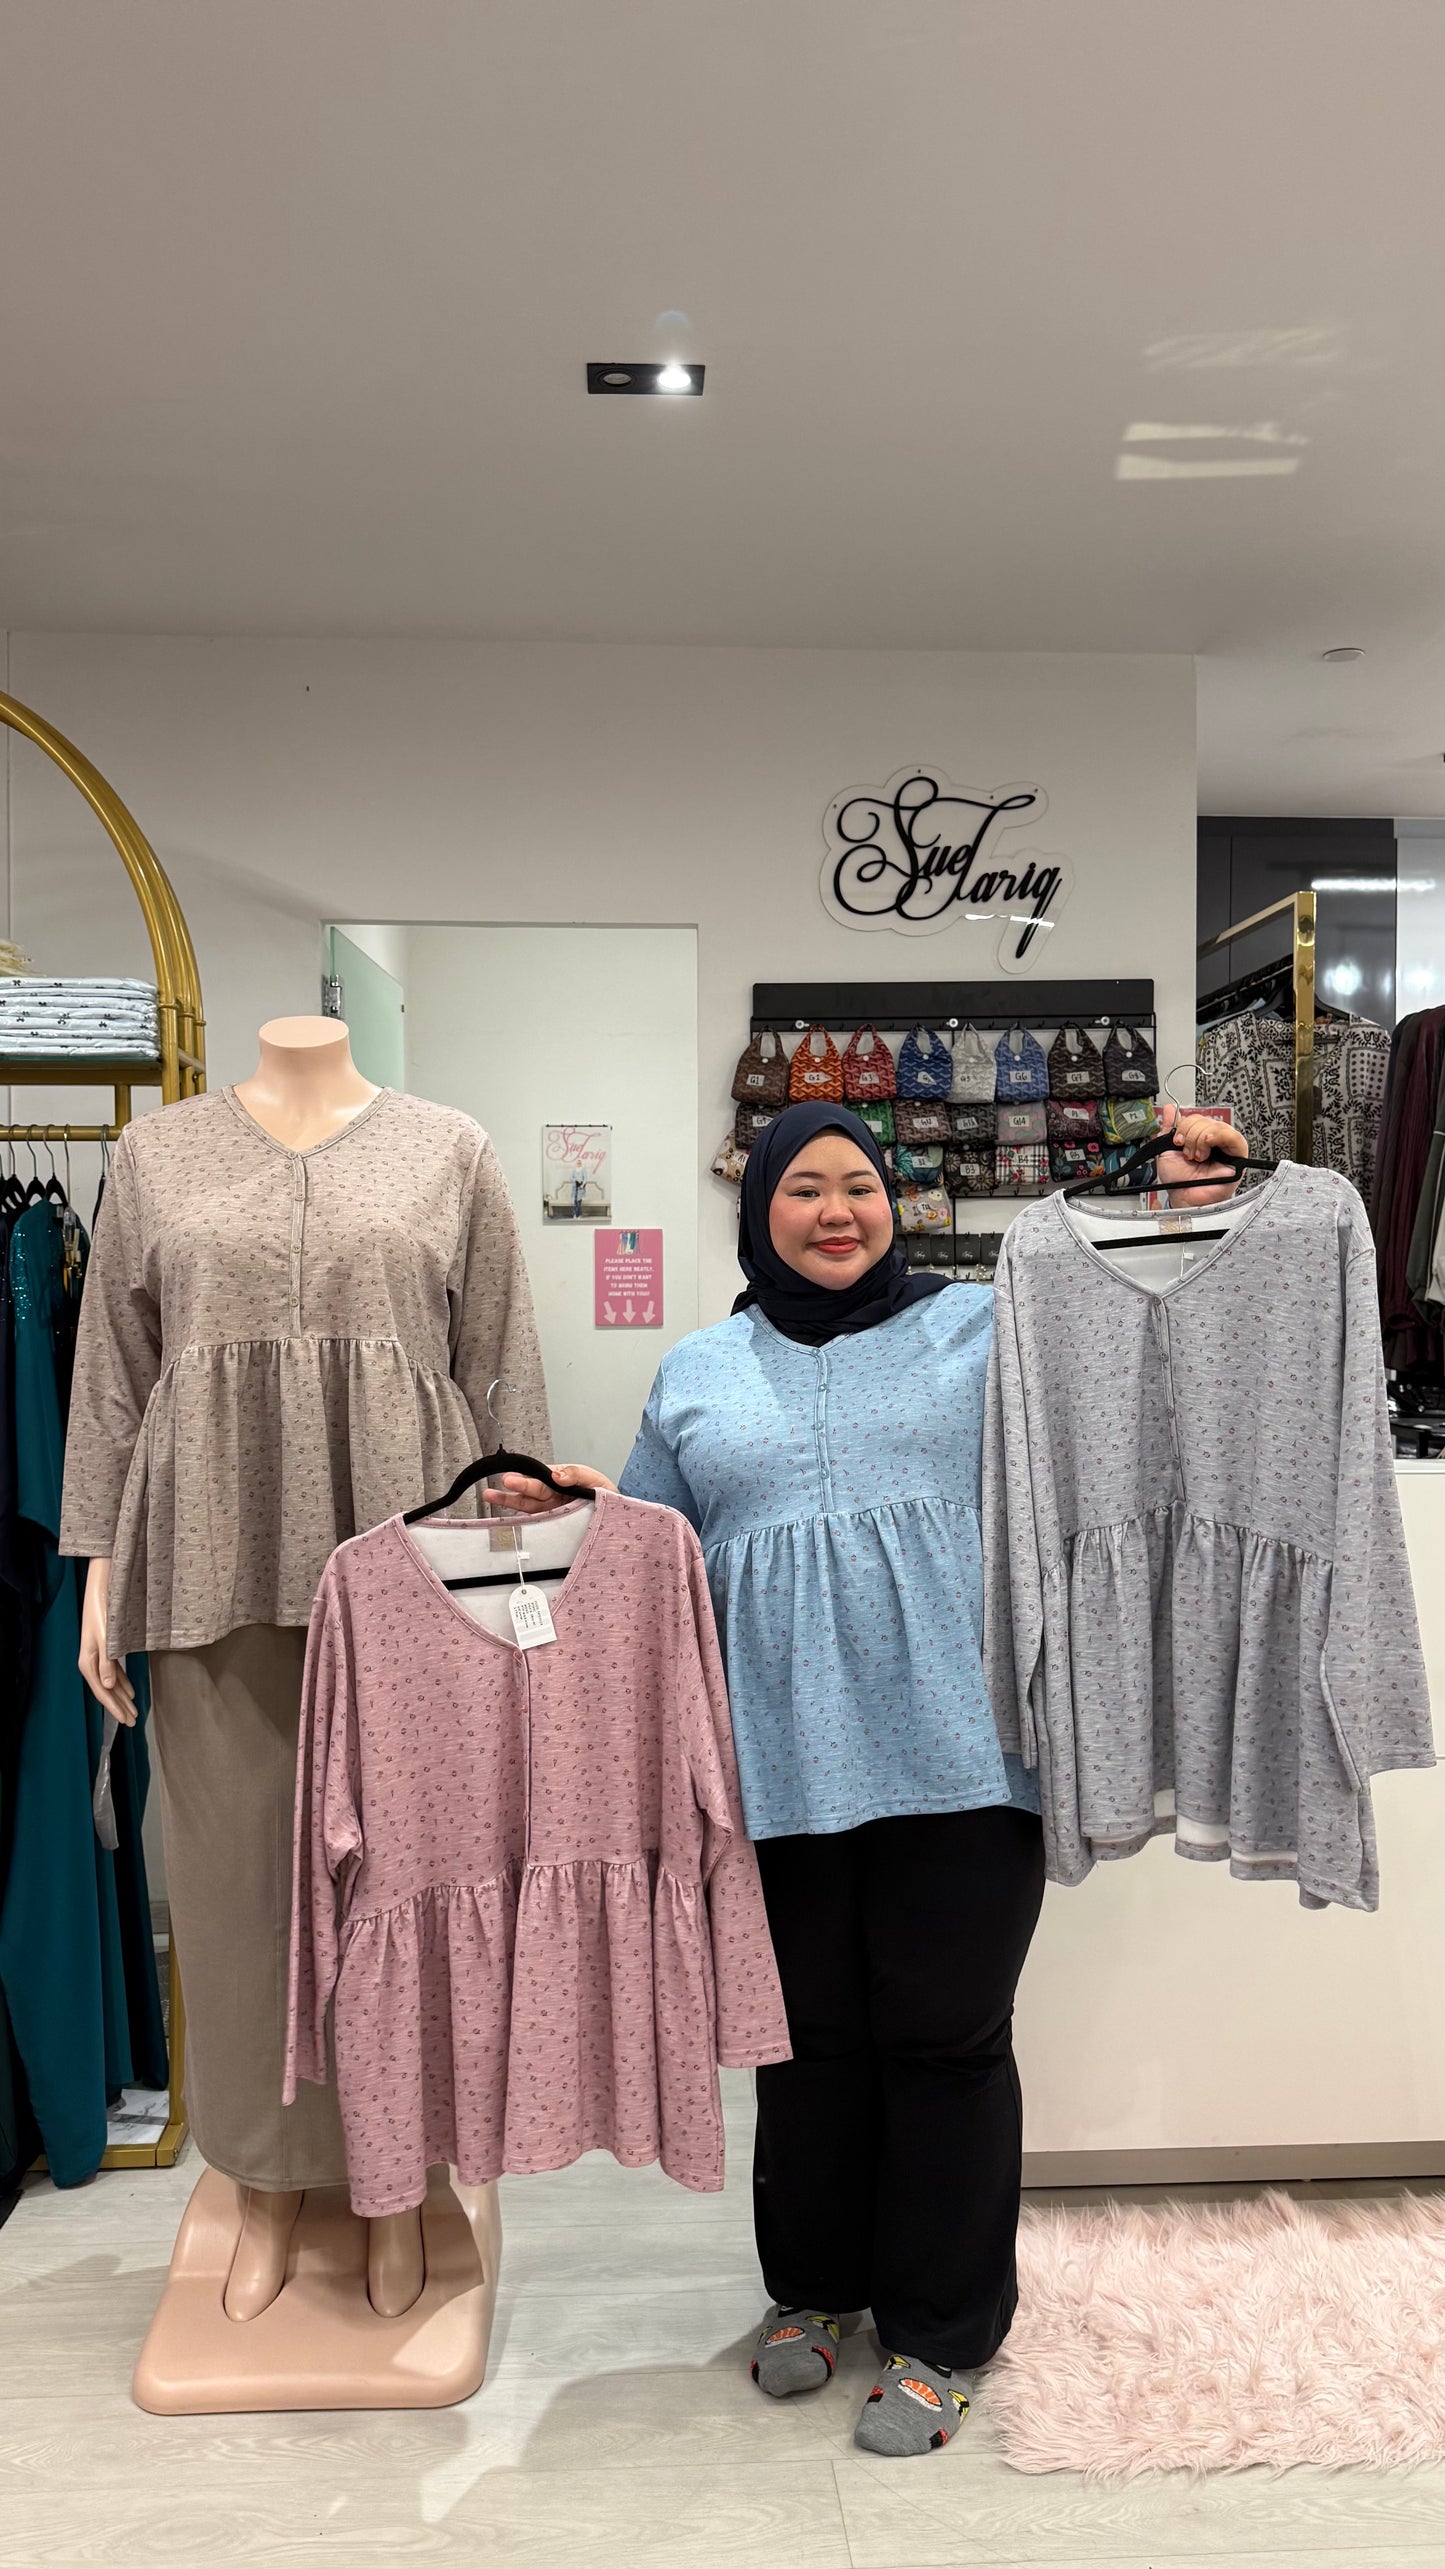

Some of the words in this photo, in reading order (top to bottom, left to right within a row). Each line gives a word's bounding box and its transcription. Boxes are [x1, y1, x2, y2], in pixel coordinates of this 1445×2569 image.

[833, 776, 974, 916] Sue
[896, 794, 1063, 959] Tariq
[750, 1076, 760, 1085] G1
[1014, 1072, 1027, 1081] G6
[1071, 1073, 1083, 1082] G7
[1128, 1072, 1140, 1080] G8
[1012, 1116, 1026, 1125] G14
[1018, 1156, 1029, 1164] B4
[1070, 1151, 1081, 1160] B5
[965, 1165, 976, 1174] B3
